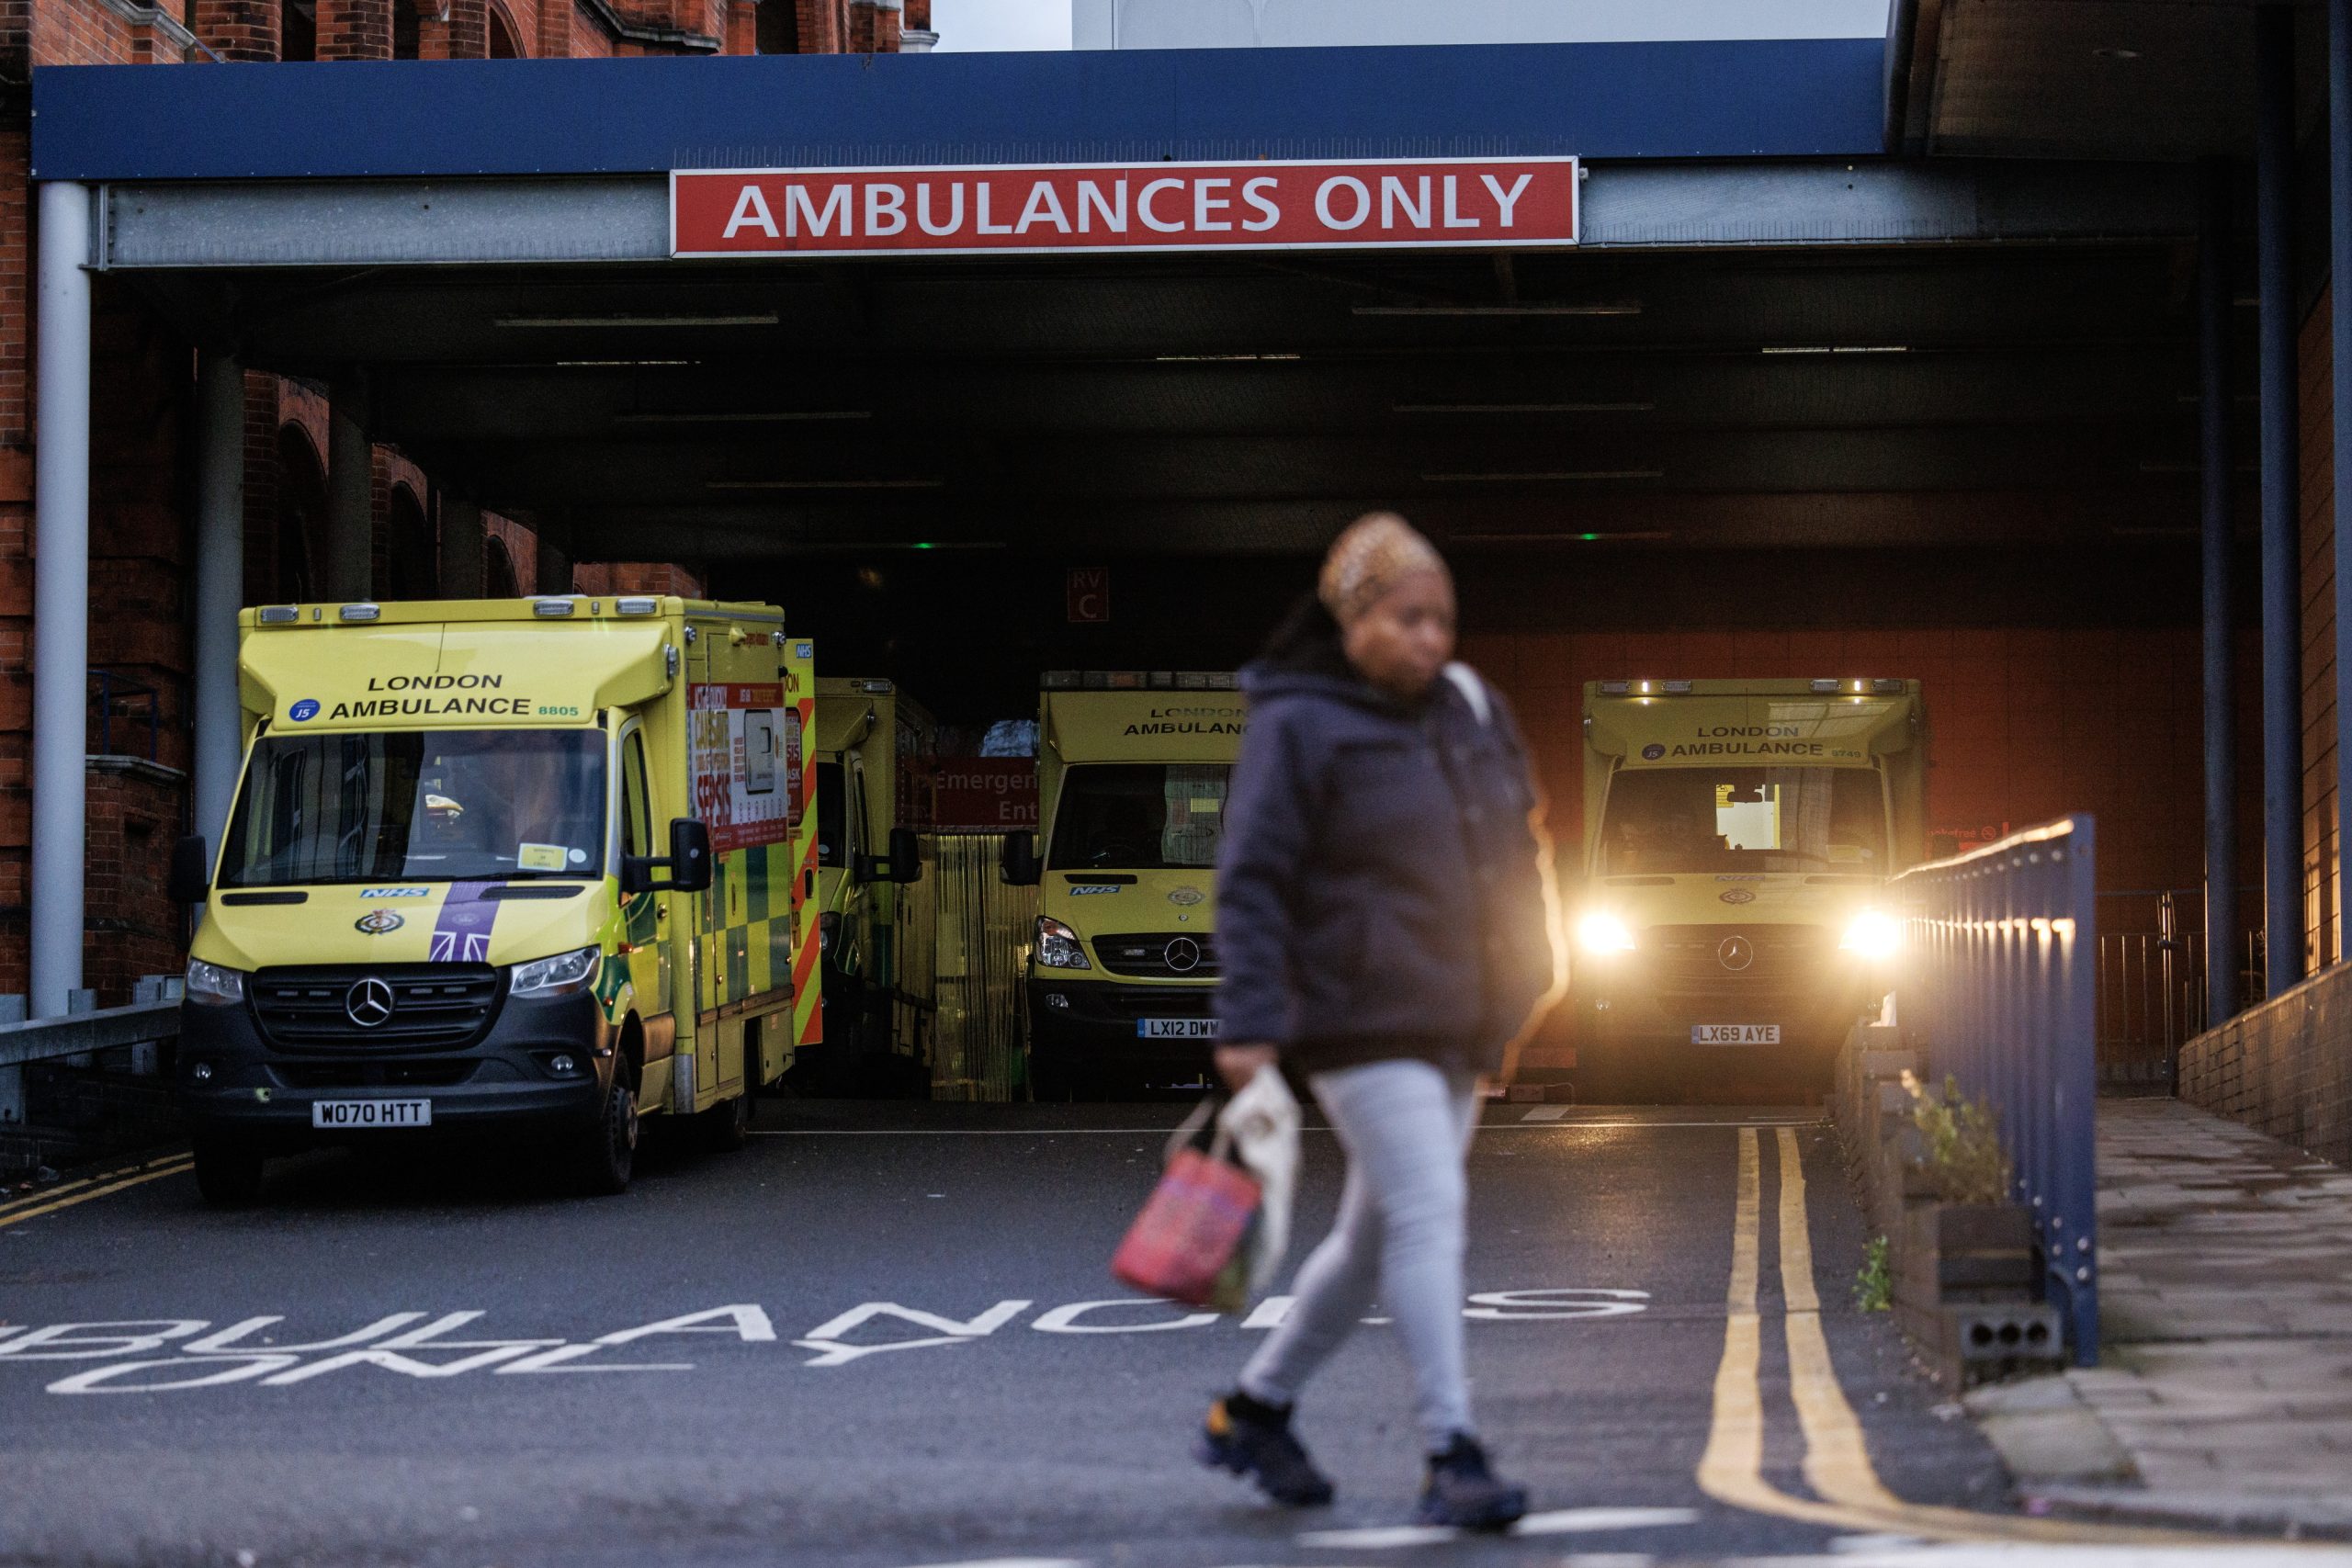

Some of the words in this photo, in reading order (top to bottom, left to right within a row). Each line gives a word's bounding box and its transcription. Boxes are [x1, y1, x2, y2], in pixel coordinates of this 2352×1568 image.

[721, 175, 1281, 239] AMBULANCES
[1315, 174, 1533, 231] ONLY
[1073, 570, 1102, 588] RV
[1079, 593, 1098, 618] C
[797, 645, 811, 658] NHS
[368, 674, 503, 691] LONDON
[329, 697, 531, 719] AMBULANCE
[538, 705, 579, 716] 8805
[1124, 722, 1248, 736] AMBULAN
[1697, 727, 1799, 737] LONDON
[1671, 742, 1824, 756] AMBULANCE
[936, 770, 1038, 795] Emergen
[697, 773, 731, 829] SEPSIS
[999, 800, 1038, 820] Ent
[362, 888, 427, 897] NHS
[1071, 886, 1118, 896] NHS
[1151, 1021, 1184, 1035] LX12
[1700, 1027, 1740, 1042] LX69
[1745, 1027, 1775, 1042] AYE
[381, 1103, 422, 1122] HTT
